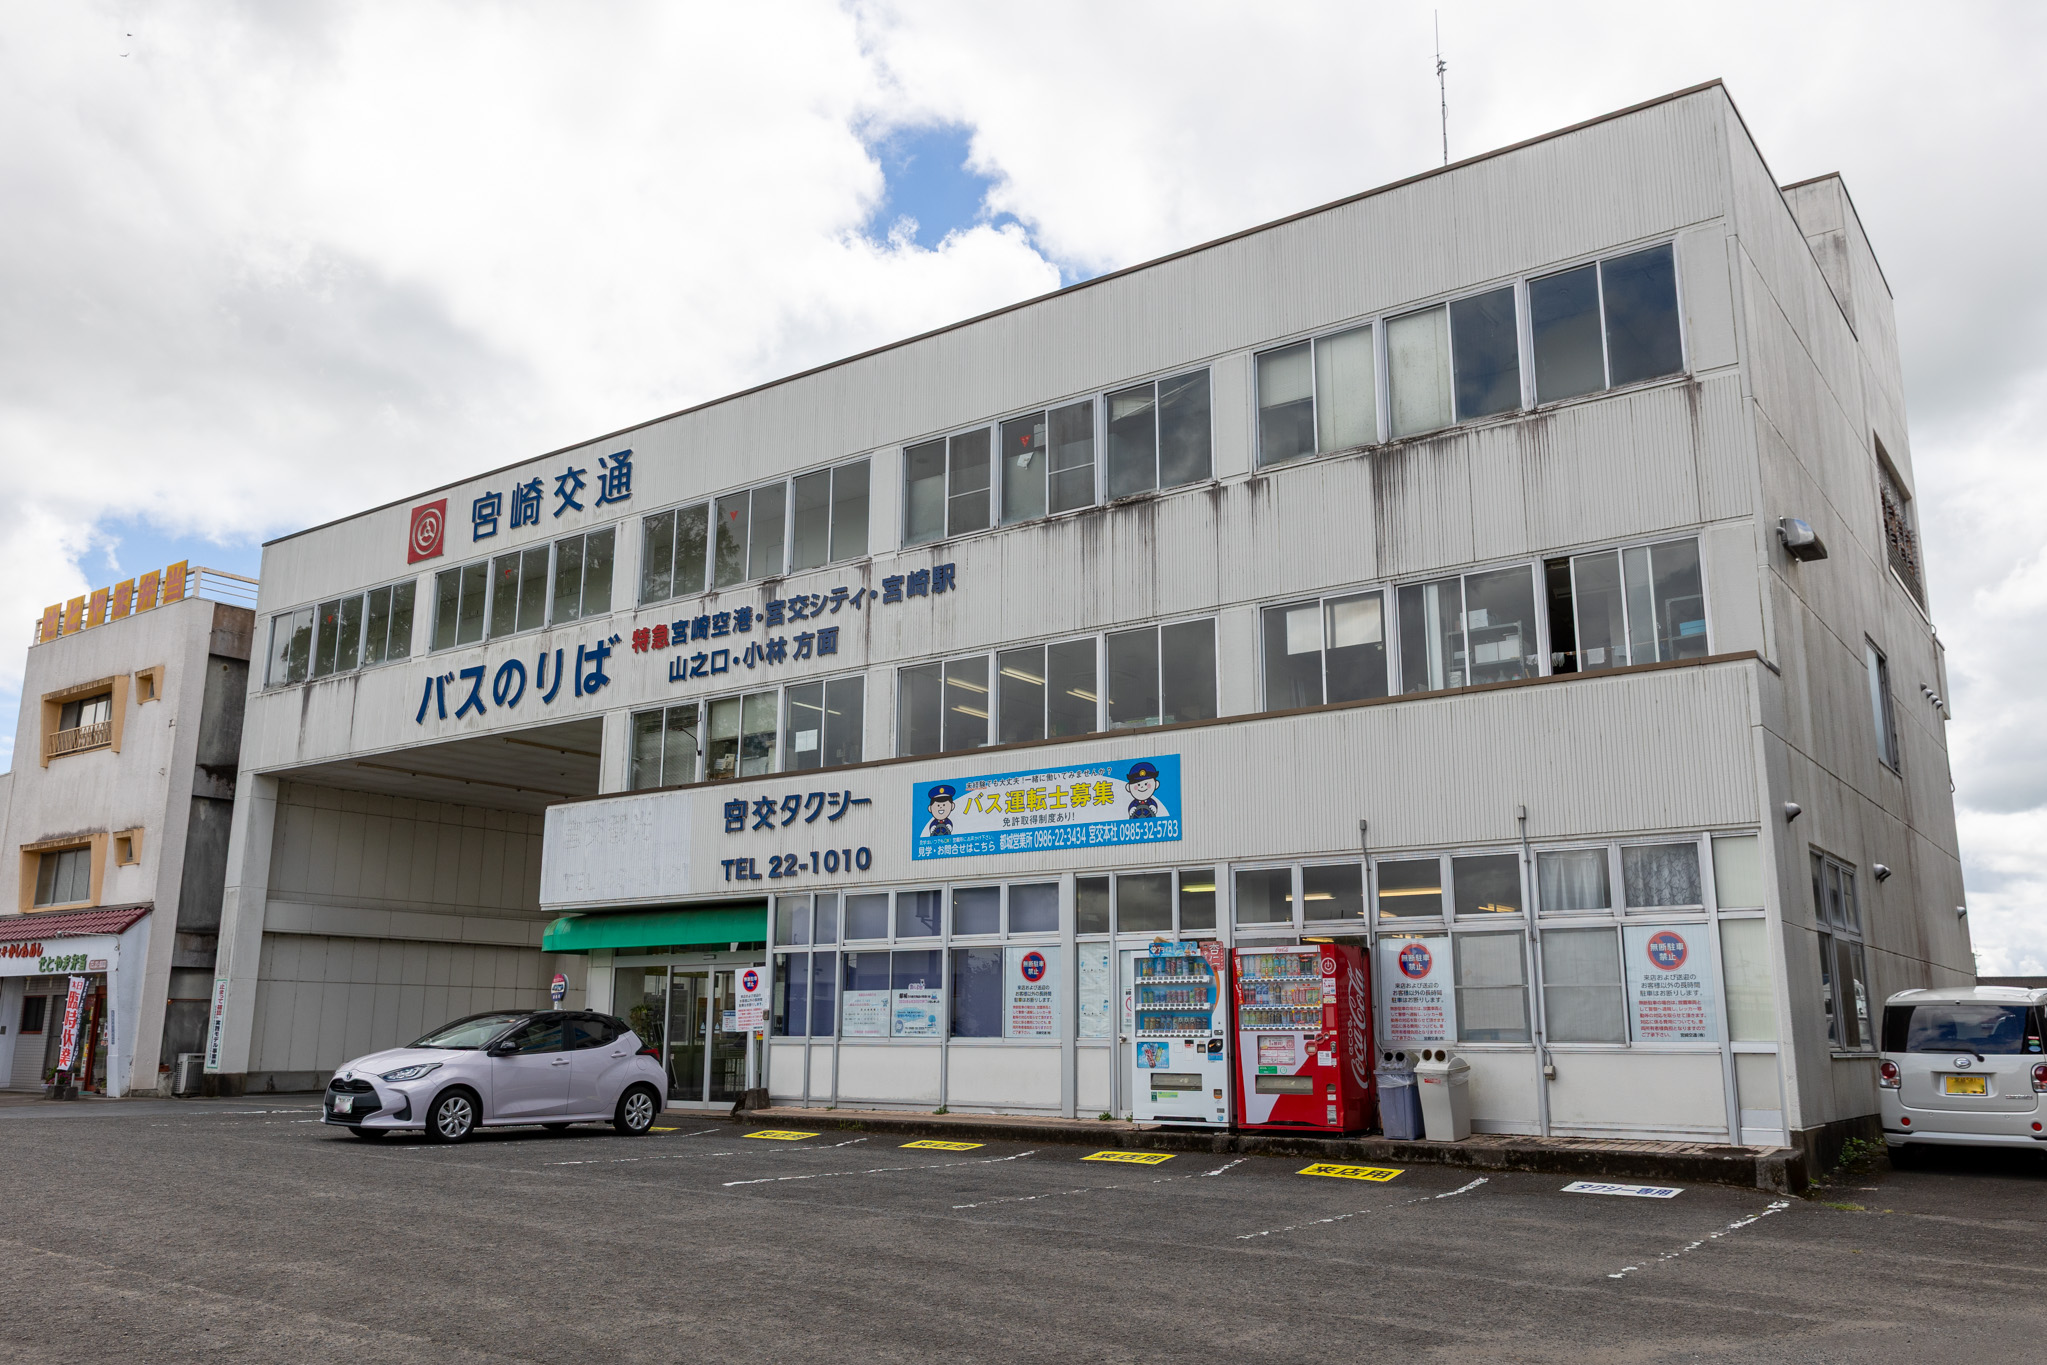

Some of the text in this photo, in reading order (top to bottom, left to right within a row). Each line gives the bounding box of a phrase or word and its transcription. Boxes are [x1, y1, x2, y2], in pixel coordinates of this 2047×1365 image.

[471, 448, 634, 543] 宮崎交通
[43, 566, 184, 638] せとやま弁当
[415, 633, 622, 725] バスのりば
[724, 790, 873, 834] 宮交タクシー
[963, 780, 1115, 815] バス運転士募集
[917, 819, 1179, 857] 見学・お問合せはこちら 都城営業所 0986-22-3434 宮交本社 0985-32-5783
[721, 846, 873, 882] TEL 22-1010
[38, 954, 88, 972] せとやま弁当
[1650, 942, 1685, 952] 無断駐車
[1659, 952, 1677, 961] 禁止
[1408, 963, 1423, 971] 禁止
[59, 990, 80, 1067] 臨時休業
[1347, 959, 1369, 1089] Coca-Cola
[1315, 1165, 1396, 1180] 来店用
[1575, 1183, 1675, 1196] タクシー専用
